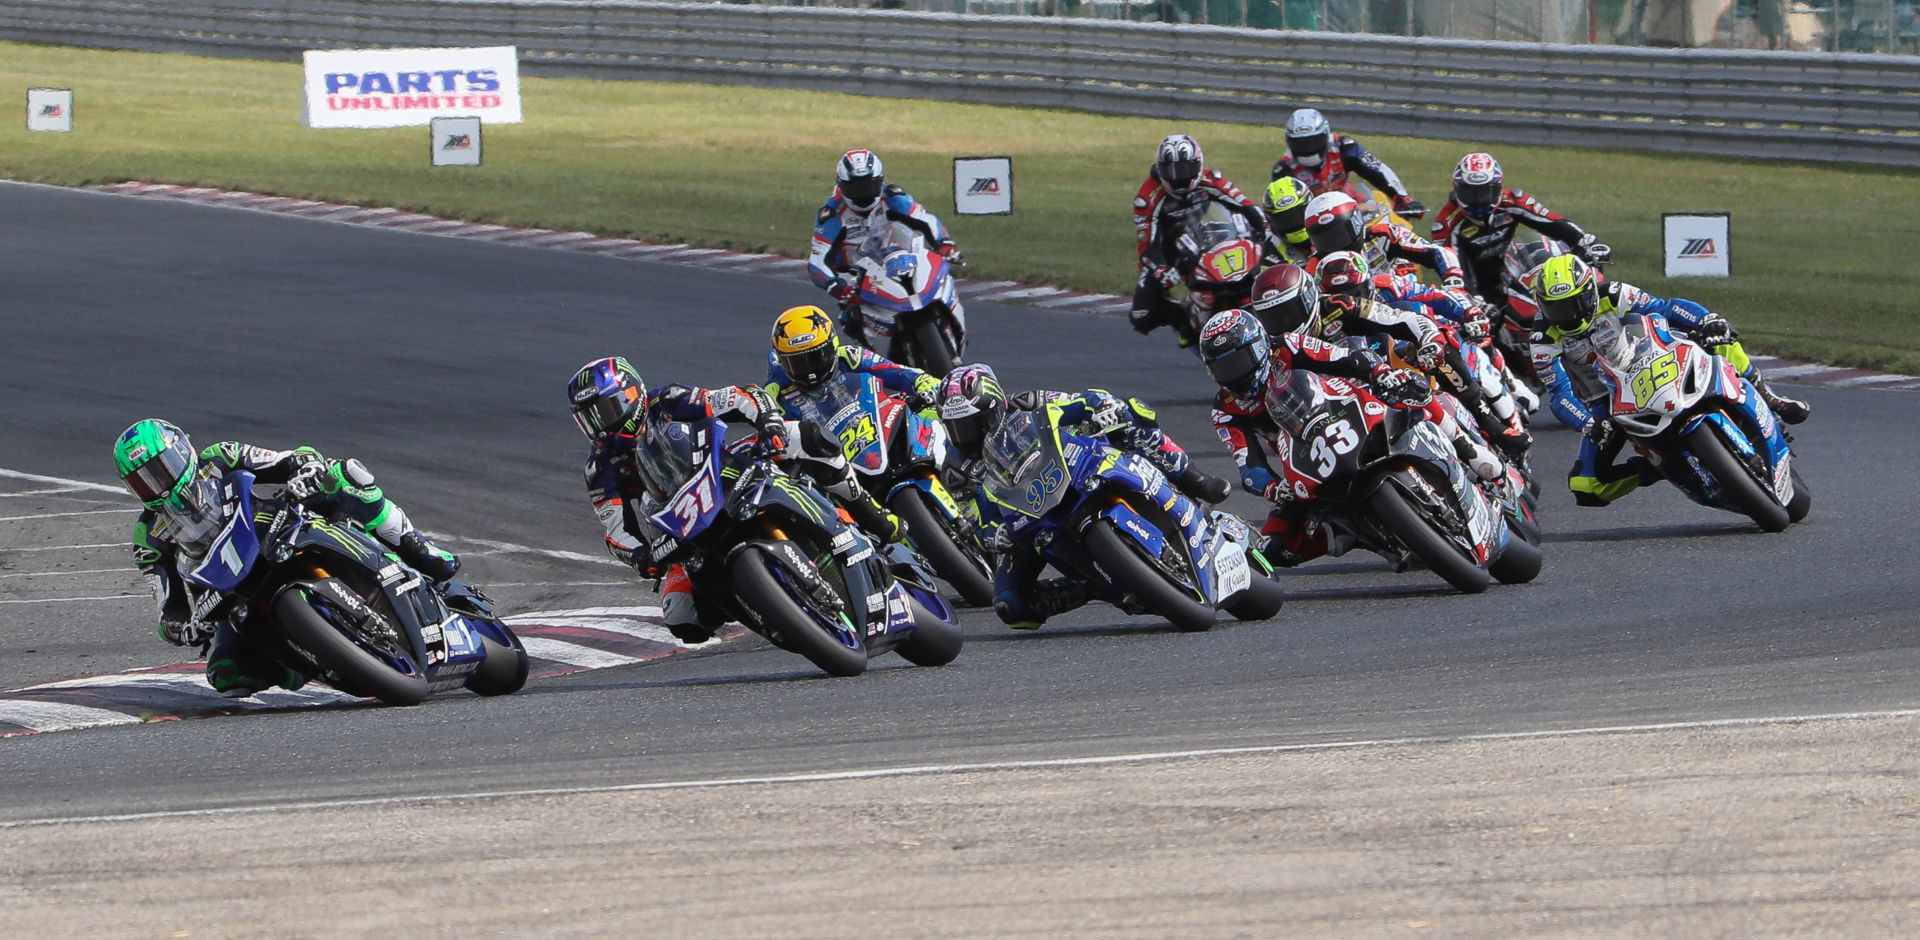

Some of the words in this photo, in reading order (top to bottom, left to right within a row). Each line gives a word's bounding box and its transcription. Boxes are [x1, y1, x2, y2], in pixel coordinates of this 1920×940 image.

[324, 69, 500, 94] PARTS
[326, 94, 500, 111] UNLIMITED
[1214, 248, 1245, 277] 17
[1551, 284, 1570, 295] Arai
[1326, 322, 1342, 334] BELL
[1631, 350, 1679, 409] 85
[829, 405, 860, 431] SUZUKI
[884, 404, 903, 429] MOTUL
[1560, 398, 1587, 420] SUZUKI
[839, 415, 875, 463] 24
[1310, 419, 1359, 478] 33
[1026, 458, 1063, 513] 95
[674, 475, 714, 537] 31
[220, 538, 244, 576] 1
[653, 538, 679, 562] YAMAHA
[197, 591, 222, 620] YAMAHA
